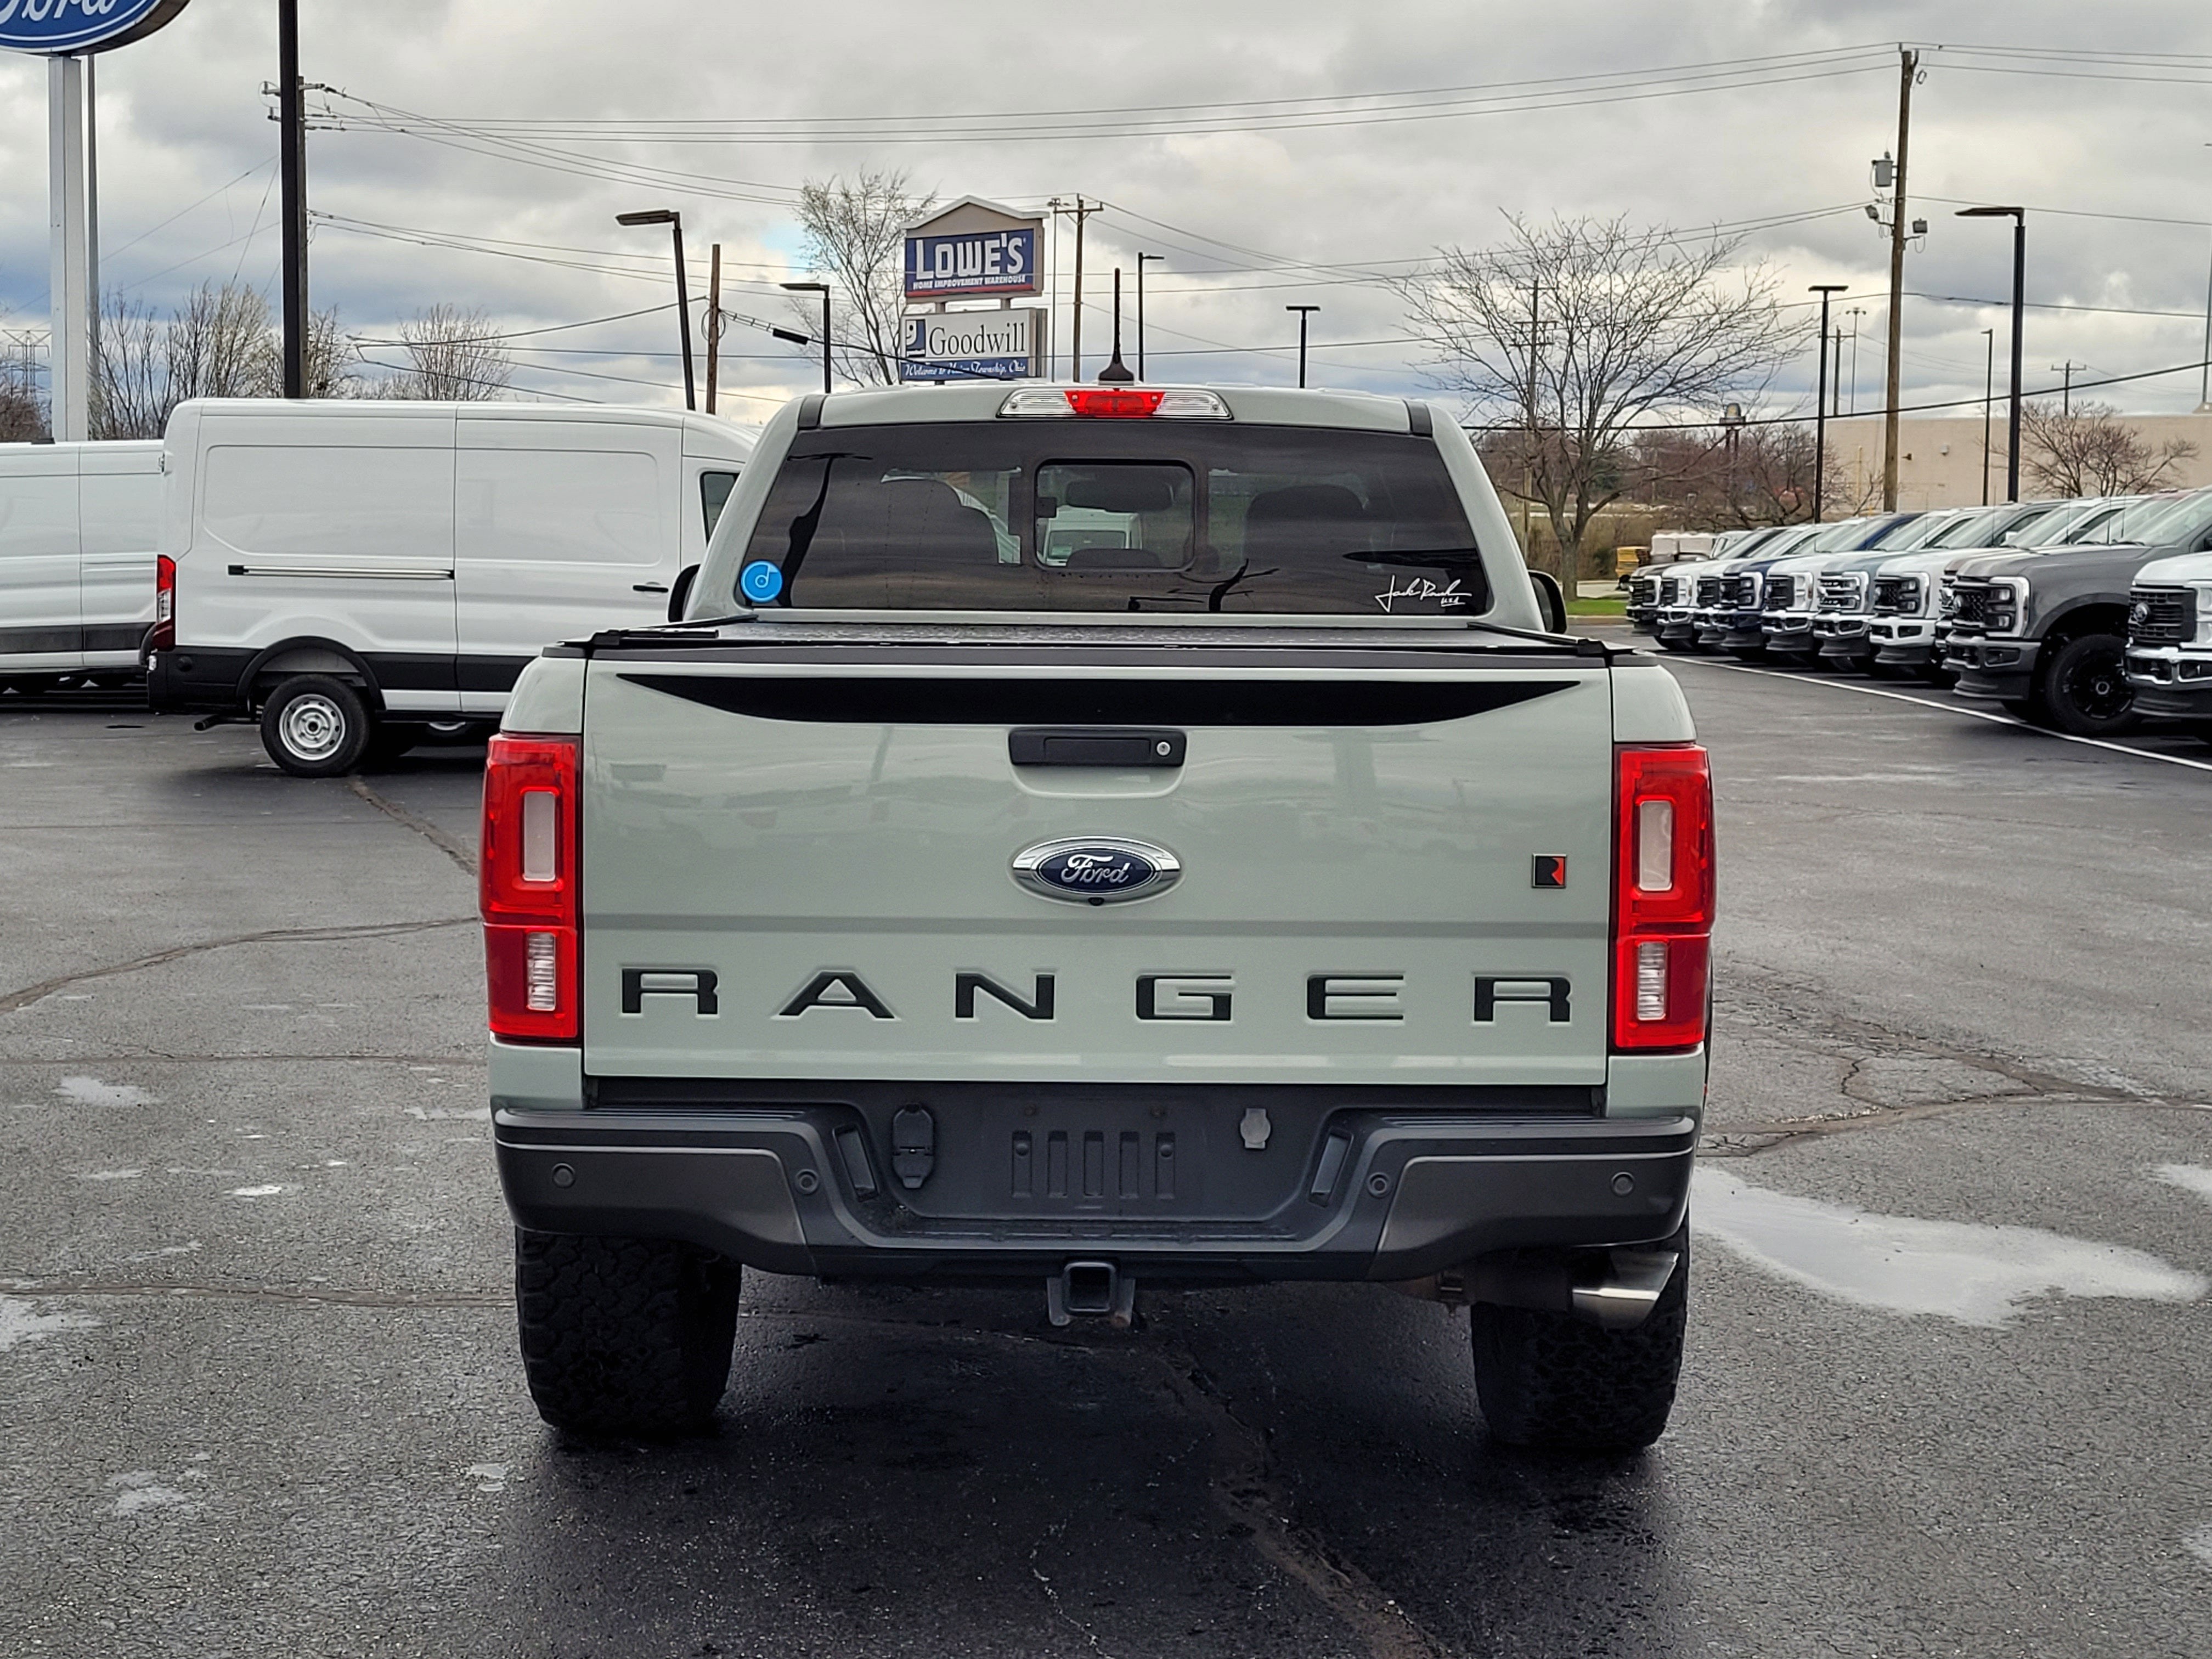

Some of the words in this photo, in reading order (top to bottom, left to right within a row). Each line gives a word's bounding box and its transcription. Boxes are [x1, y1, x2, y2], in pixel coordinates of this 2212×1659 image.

[915, 233, 1024, 280] LOWE'S
[913, 281, 933, 290] HOME
[934, 278, 984, 288] IMPROVEMENT
[984, 275, 1026, 285] WAREHOUSE
[929, 322, 1026, 356] Goodwill
[1060, 853, 1130, 883] Ford
[620, 967, 1572, 1023] RANGER
